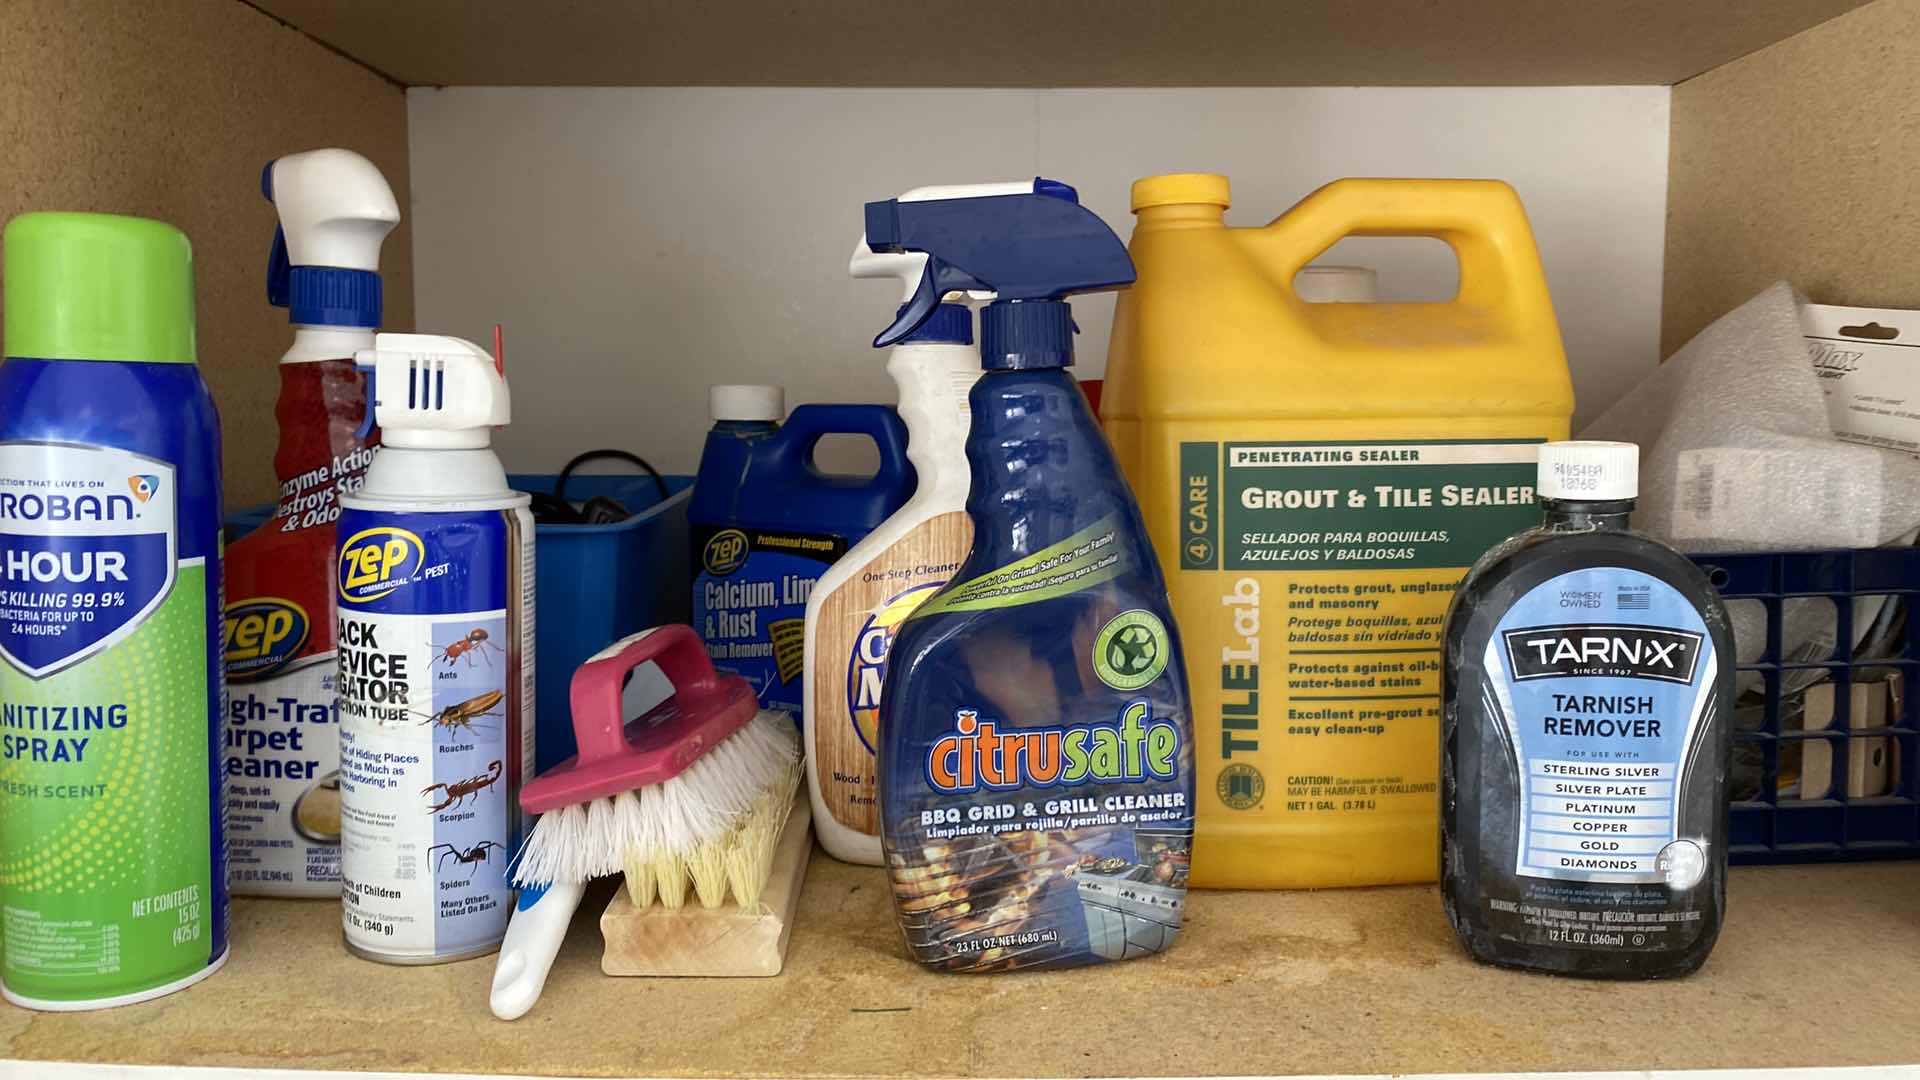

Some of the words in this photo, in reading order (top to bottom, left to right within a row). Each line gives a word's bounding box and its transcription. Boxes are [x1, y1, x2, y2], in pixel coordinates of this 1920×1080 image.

[1238, 451, 1353, 463] PENETRATING
[1359, 449, 1420, 461] SEALER
[55, 480, 84, 489] LIVES
[1189, 475, 1208, 533] CARE
[1348, 488, 1365, 506] &
[281, 514, 299, 533] &
[302, 504, 343, 529] Odo
[757, 535, 801, 548] Professional
[801, 538, 834, 551] Strength
[1242, 532, 1318, 544] SELLADOR
[1324, 532, 1361, 543] PARA
[1367, 530, 1450, 544] BOQUILLAS,
[1241, 549, 1319, 561] AZULEJOS
[1325, 549, 1335, 560] Y
[1338, 548, 1415, 560] BALDOSAS
[425, 563, 450, 579] PEST
[997, 573, 1009, 583] On
[1011, 563, 1040, 580] Grime!
[1040, 556, 1058, 571] Safe
[1060, 552, 1073, 564] For
[1073, 545, 1090, 559] Your
[863, 572, 885, 583] One
[887, 568, 912, 582] Step
[915, 562, 961, 577] Cleaner
[359, 577, 408, 595] COMMERCIAL
[977, 590, 1000, 600] contra
[1075, 566, 1091, 579] para
[1289, 584, 1349, 594] Protects
[1354, 583, 1396, 597] grout,
[9, 591, 67, 608] KILLING
[72, 592, 125, 608] 99.9%
[705, 577, 779, 610] Calcium,
[1289, 599, 1314, 609] and
[1320, 599, 1379, 611] masonry
[1560, 600, 1601, 609] OWNED
[42, 611, 61, 622] FOR
[64, 611, 78, 622] UP
[80, 611, 94, 622] TO
[705, 615, 716, 638] &
[719, 609, 757, 638] Rust
[1288, 617, 1341, 629] Protege
[1347, 614, 1411, 629] boquillas,
[12, 622, 23, 634] 24
[336, 618, 378, 649] ACK
[1288, 631, 1348, 642] baldosas
[1378, 630, 1432, 641] vidriado
[729, 642, 773, 658] Remover
[337, 645, 408, 679] EVICE
[1289, 664, 1349, 674] Protects
[1354, 662, 1404, 676] against
[438, 671, 458, 680] Ants
[1609, 668, 1632, 676] 1967
[1289, 678, 1376, 689] water-based
[1380, 676, 1421, 687] stains
[1552, 694, 1653, 714] TARNISH
[0, 702, 128, 731] NITIZING
[370, 706, 409, 721] TUBE
[1288, 709, 1353, 719] Excellent
[1359, 707, 1421, 721] pre-grout
[1288, 725, 1320, 737] easy
[1325, 722, 1385, 737] clean-up
[1544, 718, 1661, 738] REMOVER
[4, 734, 88, 762] SPRAY
[356, 747, 382, 763] Hiding
[384, 753, 419, 763] Places
[439, 743, 474, 753] Roaches
[364, 763, 390, 775] Much
[1544, 764, 1610, 777] STERLING
[1615, 767, 1660, 777] SILVER
[349, 771, 386, 788] Harboring
[833, 772, 861, 786] Wood
[1288, 775, 1333, 785] CAUTION!
[43, 784, 107, 798] SCENT
[1288, 786, 1308, 797] MAY
[1311, 786, 1322, 796] BE
[1324, 785, 1367, 796] HARMFUL
[1381, 783, 1436, 795] SWALLOWED
[1555, 783, 1601, 795] SILVER
[1606, 785, 1647, 796] PLATE
[921, 808, 961, 826] BBQ
[968, 804, 1015, 821] GRID
[1022, 802, 1037, 816] &
[1045, 799, 1098, 815] GRILL
[1104, 793, 1185, 811] CLEANER
[1288, 801, 1304, 811] NET
[1566, 803, 1636, 814] PLATINUM
[439, 812, 475, 823] Scorpion
[926, 824, 989, 839] Limpiador
[993, 821, 1022, 836] para
[1121, 814, 1136, 824] de
[1140, 810, 1182, 821] asador
[1573, 822, 1628, 833] COPPER
[1581, 841, 1619, 851] GOLD
[1561, 858, 1637, 870] DIAMONDS
[364, 884, 401, 899] Children
[440, 880, 470, 889] Spiders
[132, 897, 151, 918] NET
[154, 884, 199, 913] CONTENTS
[441, 899, 463, 910] Many
[465, 894, 489, 904] Others
[441, 906, 466, 918] Listed
[468, 904, 479, 913] On
[480, 900, 497, 912] Back
[364, 918, 382, 933] (340
[384, 924, 394, 936] g)
[998, 936, 1017, 949] NET
[1018, 933, 1040, 949] (680
[1042, 930, 1057, 945] mL)
[1549, 930, 1559, 942] 12
[1590, 934, 1624, 947] (360ml)
